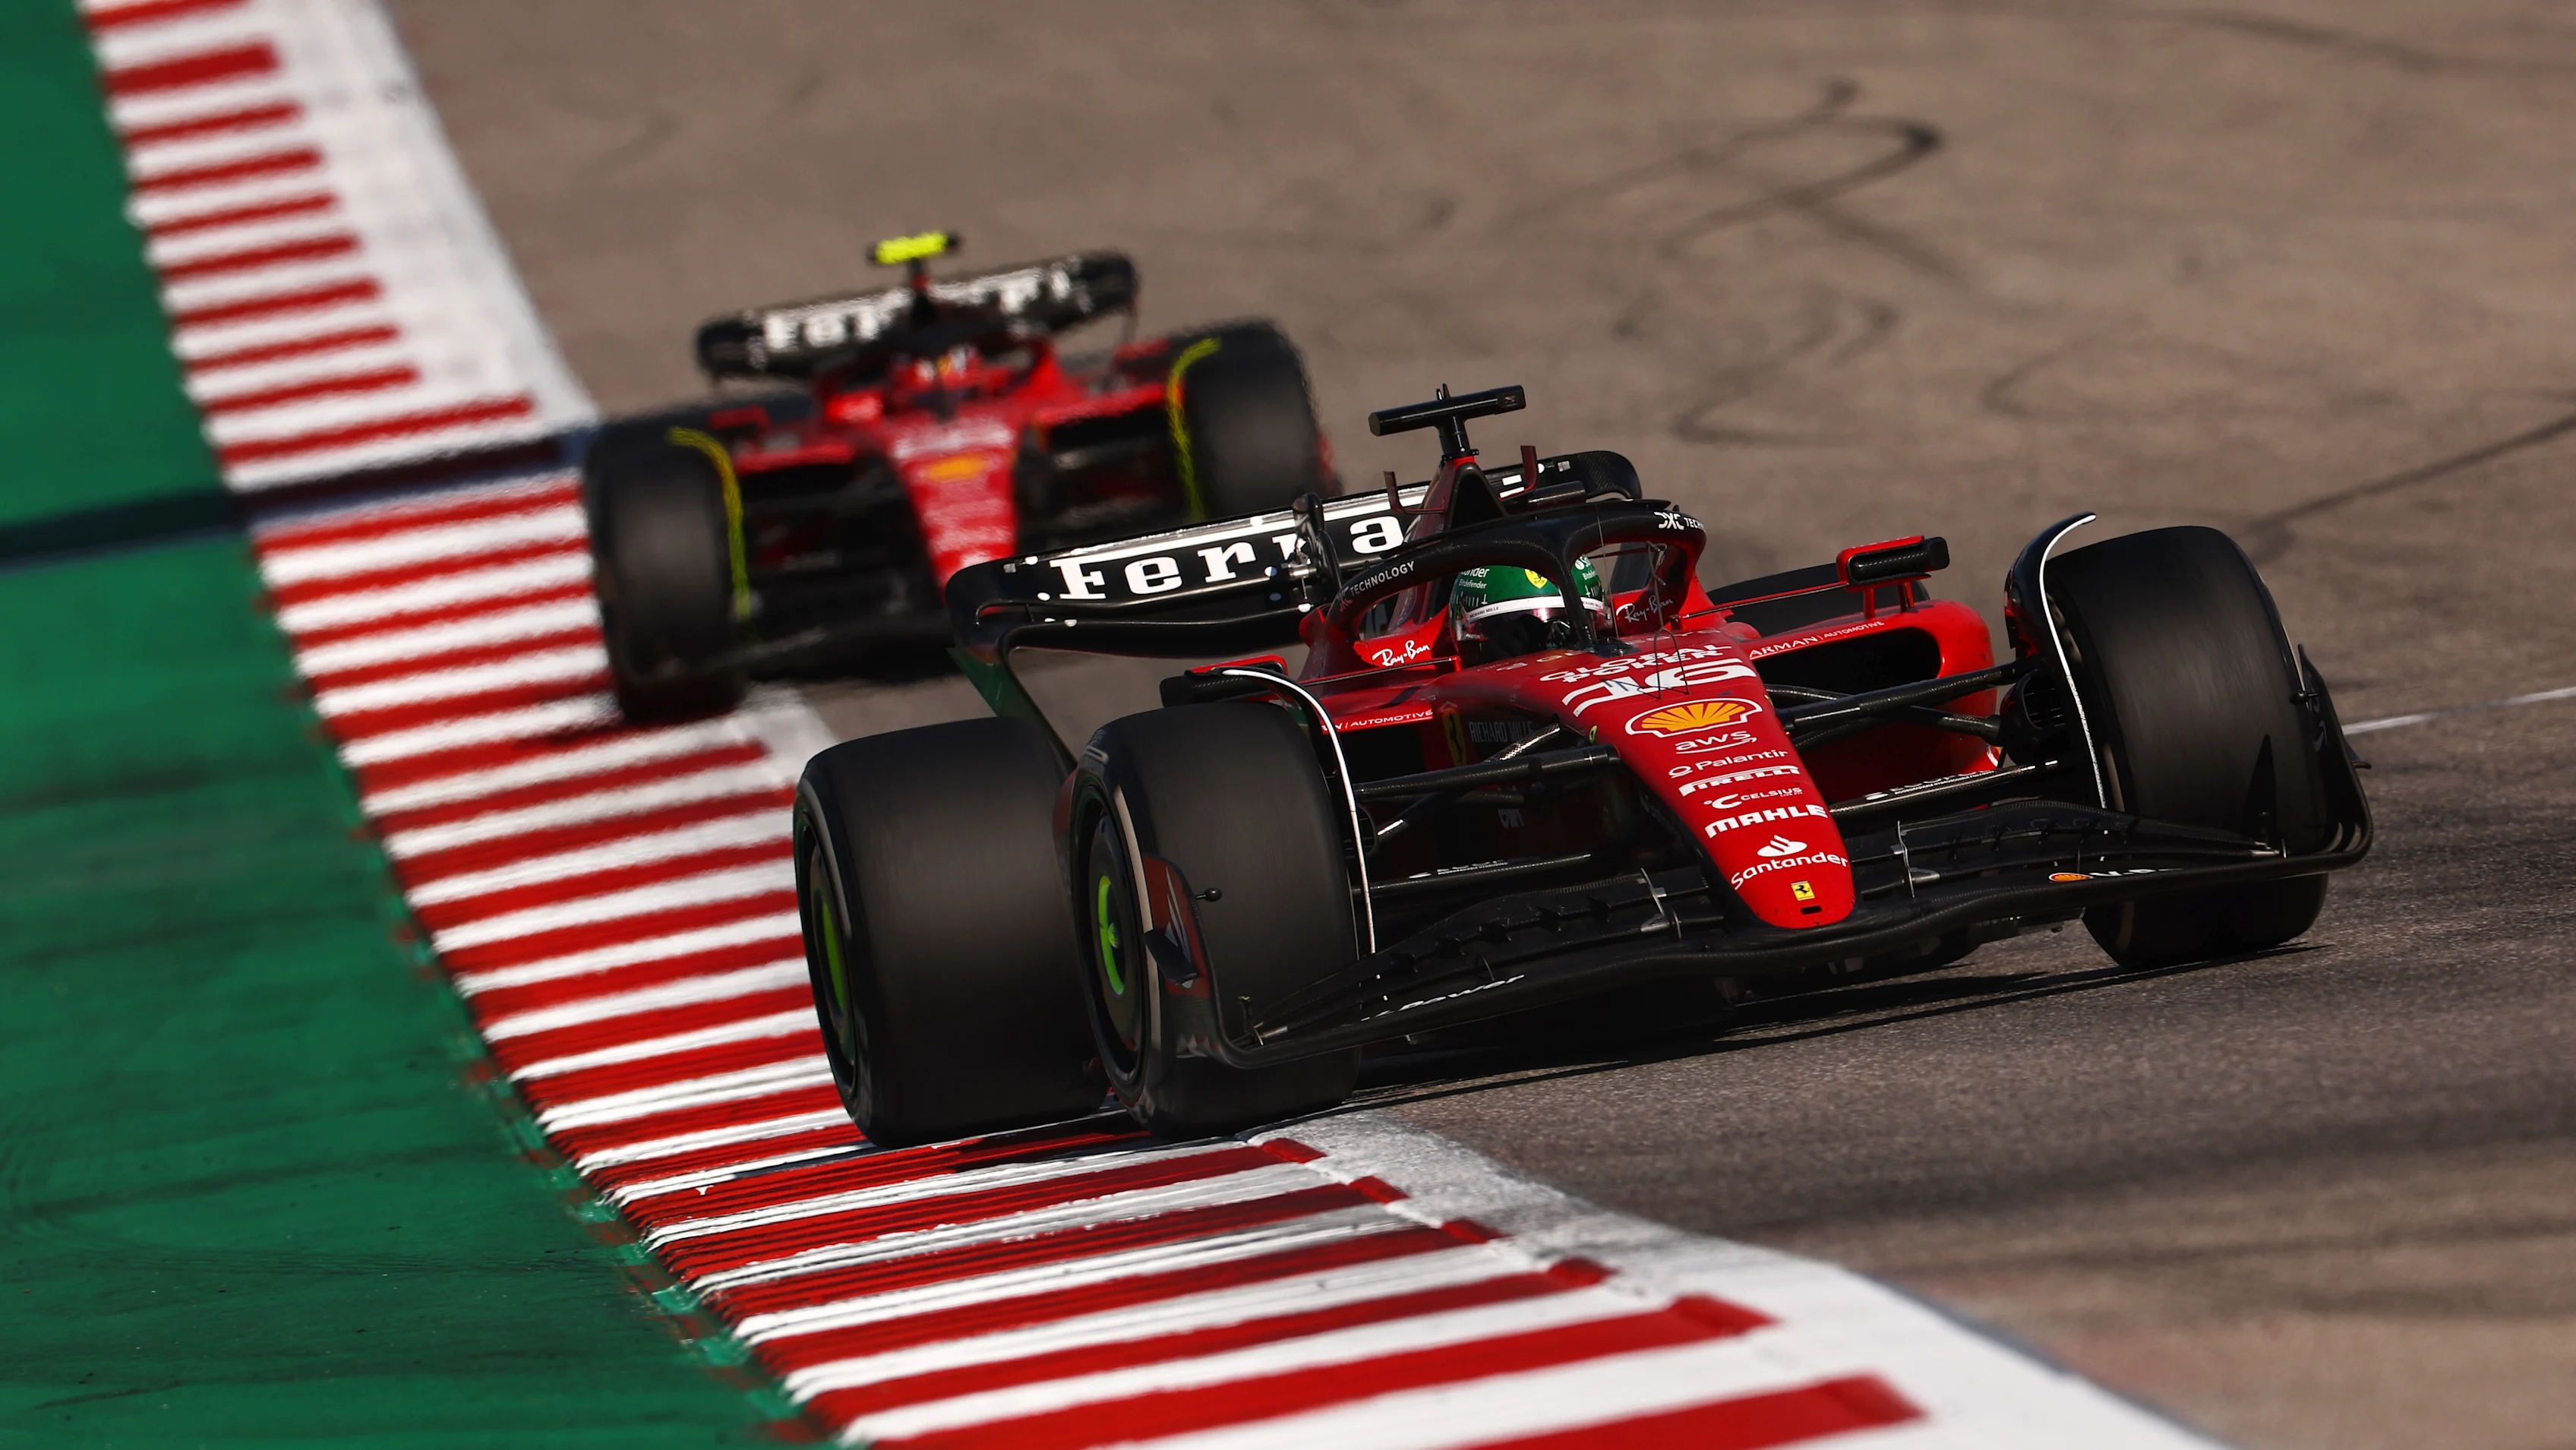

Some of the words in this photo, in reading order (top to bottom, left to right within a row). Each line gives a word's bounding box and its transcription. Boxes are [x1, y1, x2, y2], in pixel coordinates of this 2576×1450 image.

[1350, 561, 1415, 596] TECHNOLOGY
[1615, 595, 1674, 622] Ray-Ban
[1372, 640, 1431, 667] Ray-Ban
[1748, 636, 1819, 658] ARMAN
[1824, 621, 1885, 639] AUTOMOTIVE
[1539, 644, 1733, 682] GLOBAL
[1561, 648, 1724, 684] POKER
[1561, 658, 1757, 718] 16
[1350, 709, 1434, 727] AUTOMOTIVE
[1468, 721, 1508, 743] RICHARD
[1675, 730, 1752, 751] aws
[1694, 749, 1788, 771] Palantir
[1678, 765, 1801, 797] PIRELLI
[1740, 787, 1803, 801] CELSIUS
[1704, 804, 1829, 839] MAHLE
[1731, 851, 1848, 891] Santander
